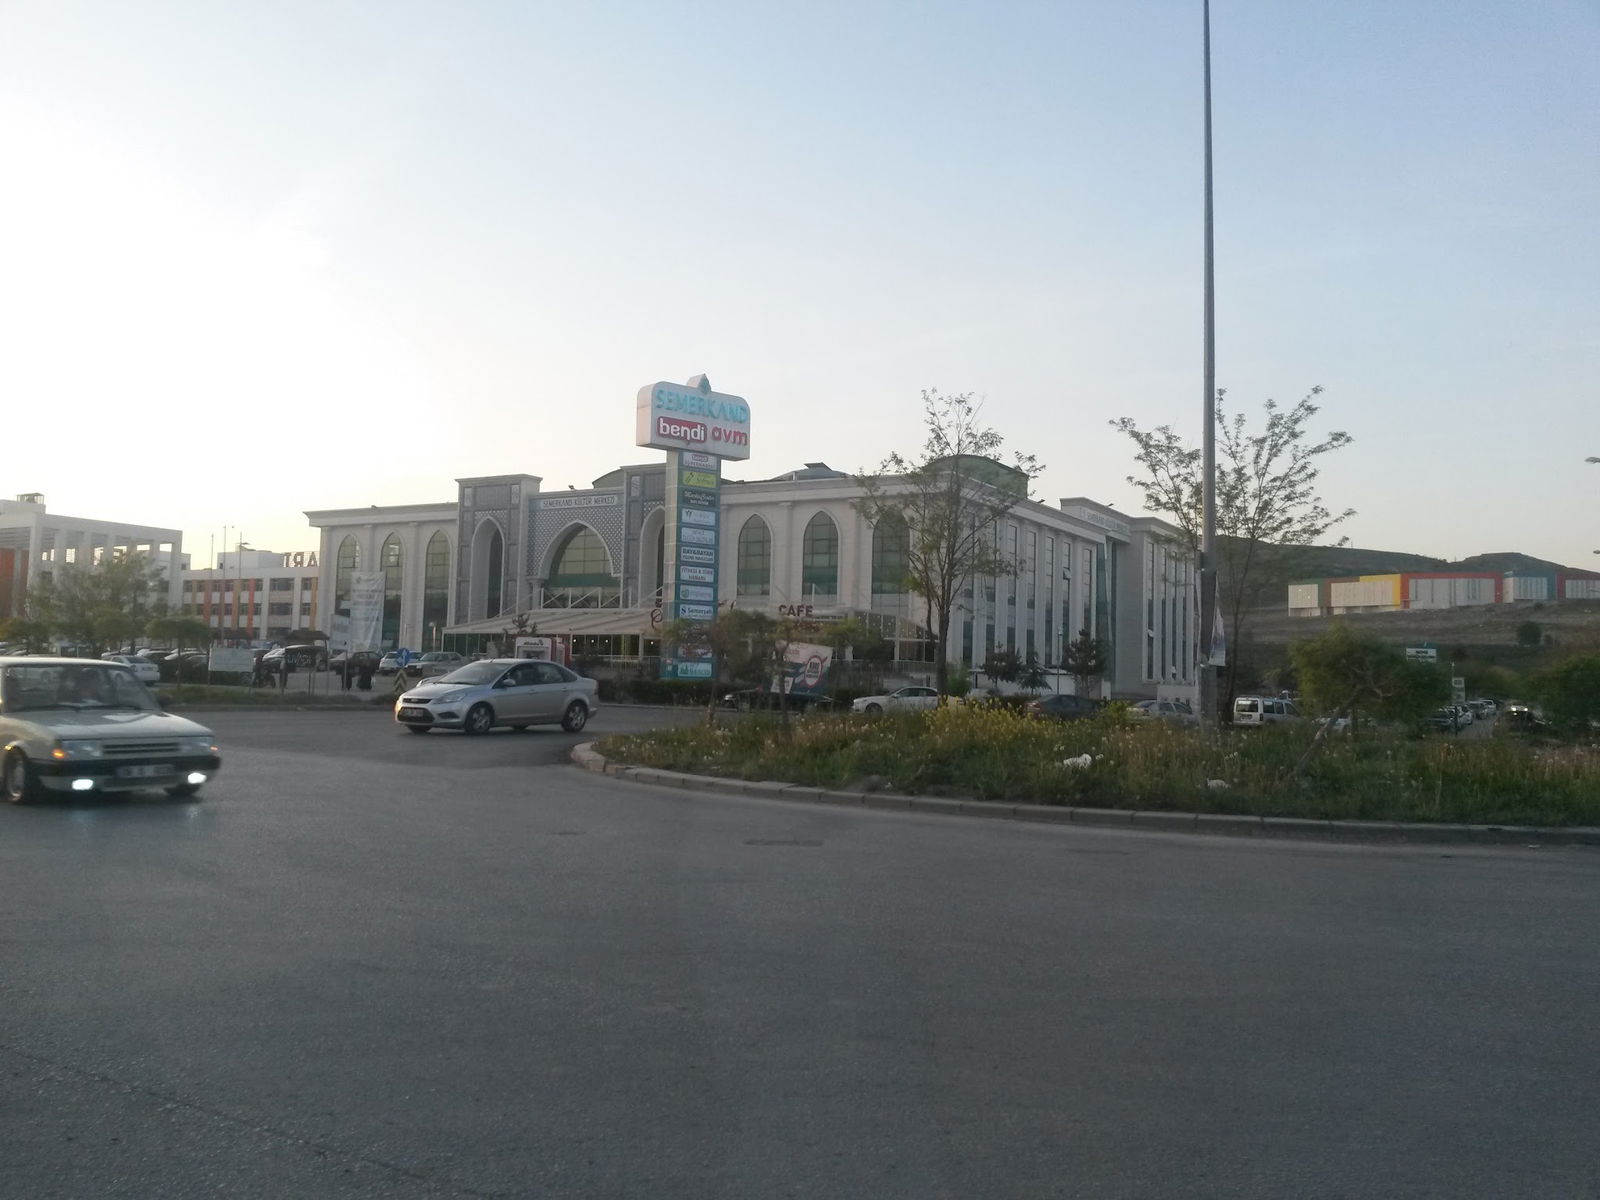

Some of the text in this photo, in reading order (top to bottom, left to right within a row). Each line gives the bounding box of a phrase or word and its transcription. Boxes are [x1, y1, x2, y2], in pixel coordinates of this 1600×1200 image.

[655, 389, 748, 424] SEMERKAND
[659, 418, 747, 446] bendi avm
[779, 604, 813, 617] CAFE
